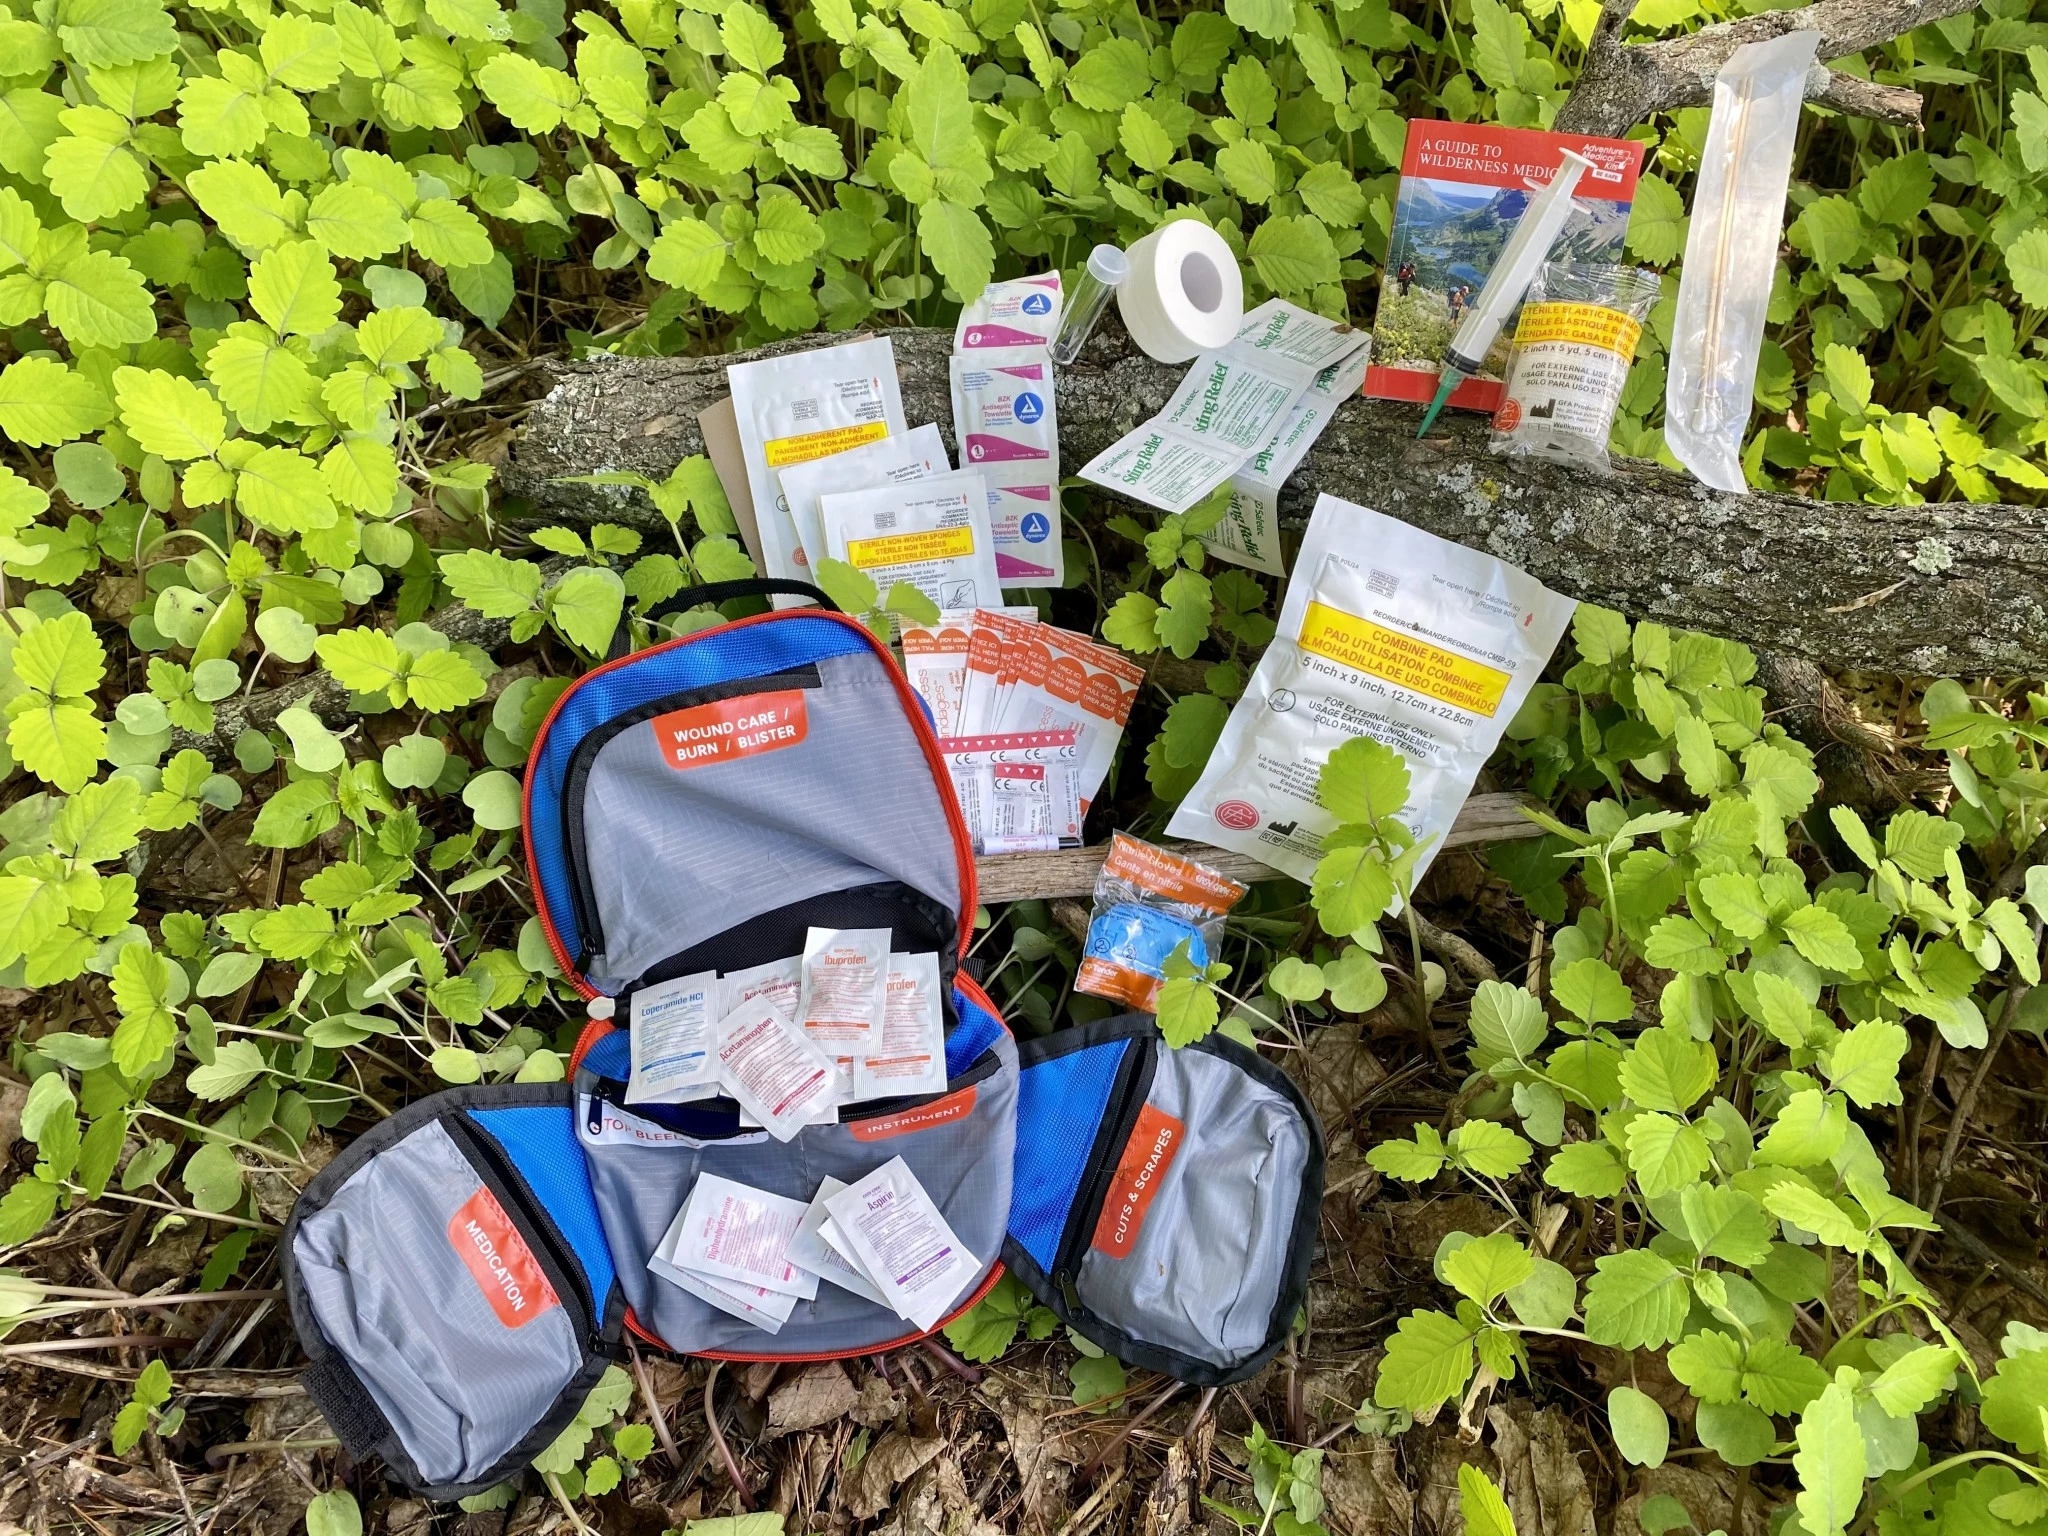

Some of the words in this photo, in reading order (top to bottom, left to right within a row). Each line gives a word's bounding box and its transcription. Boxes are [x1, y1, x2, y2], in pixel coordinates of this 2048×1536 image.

[1422, 139, 1431, 150] A
[1435, 140, 1479, 155] GUIDE
[1484, 145, 1502, 157] TO
[1582, 143, 1624, 155] Adventure
[1582, 151, 1616, 161] Medical
[1420, 153, 1508, 174] WILDERNESS
[1521, 305, 1561, 314] STERILE
[1562, 305, 1604, 318] ELASTIC
[1268, 310, 1291, 334] Relief
[1554, 316, 1609, 331] ÉLASTIQUE
[1255, 331, 1282, 350] Sting
[1517, 329, 1553, 338] VENDAS
[1555, 328, 1568, 336] DE
[1571, 330, 1600, 341] GASA
[1531, 343, 1548, 352] inch
[1593, 350, 1607, 359] cm
[1547, 371, 1585, 382] EXTERNE
[1548, 362, 1590, 375] EXTERNAL
[1592, 370, 1608, 378] USE
[1204, 361, 1229, 401] Relief
[1548, 380, 1570, 388] PARA
[1573, 383, 1590, 392] USO
[982, 403, 1012, 411] Antiseptic
[1176, 389, 1199, 420] Safetec
[1193, 403, 1219, 433] Sting
[788, 428, 846, 445] NON-ADHERENT
[848, 427, 863, 435] PAD
[1284, 417, 1313, 447] Safetec
[775, 443, 819, 456] PANSEMENT
[820, 432, 879, 447] NON-ADHÉRENT
[974, 446, 980, 454] 1
[1136, 433, 1164, 462] Relief
[772, 448, 830, 464] ALMOHADILLAS
[1106, 448, 1133, 467] Safetec
[1122, 461, 1152, 485] Sting
[1255, 510, 1264, 536] Safetec
[859, 539, 885, 549] STERILE
[888, 535, 928, 545] NON-WOVEN
[929, 530, 960, 540] SPONGES
[875, 546, 903, 555] STÉRILE
[920, 540, 947, 550] TISSÉES
[1239, 521, 1266, 562] Relief
[856, 556, 892, 567] ESPONJAS
[892, 551, 929, 564] ESTERILES
[940, 546, 968, 556] TEJIDAS
[1431, 574, 1446, 585] Tear
[1447, 582, 1464, 592] open
[1465, 586, 1480, 597] here
[1485, 593, 1512, 607] Déchirez
[1513, 604, 1521, 612] ici
[1502, 608, 1517, 619] aquí
[1373, 610, 1488, 658] REORDER/COMMANDE/REORDENAR
[1048, 629, 1069, 644] Nudillos
[1074, 643, 1096, 656] Jointure
[1100, 654, 1122, 668] Nudillos
[1372, 630, 1432, 659] COMBINE
[1430, 652, 1454, 668] PAD
[1323, 627, 1350, 644] PAD
[1352, 636, 1428, 672] UTILISATION
[1426, 667, 1485, 695] COMBINEE
[1050, 670, 1065, 681] PULL
[1066, 678, 1082, 688] HERE
[1385, 664, 1401, 678] DE
[1404, 671, 1430, 689] USO
[1431, 683, 1497, 712] COMBINADO
[1086, 686, 1099, 696] PULL
[1101, 694, 1117, 704] HERE
[1303, 656, 1311, 667] 5
[1312, 659, 1338, 678] inch
[1339, 672, 1347, 681] x
[1349, 673, 1358, 685] 9
[1359, 678, 1387, 697] inch,
[1391, 690, 1428, 711] 12.7cm
[1430, 705, 1437, 714] x
[1438, 707, 1474, 727] 22.8cm
[673, 722, 734, 743] WOUND
[737, 711, 777, 731] CARE
[1308, 700, 1343, 717] USAGE
[1341, 713, 1382, 732] EXTERNE
[1383, 726, 1440, 753] UNIQUEMENT
[1325, 696, 1345, 709] FOR
[1345, 704, 1390, 723] EXTERNAL
[1392, 719, 1410, 730] USE
[1410, 726, 1436, 740] ONLY
[676, 742, 718, 761] BURN
[737, 724, 796, 748] BLISTER
[1314, 714, 1339, 728] SOLO
[1339, 723, 1365, 737] PARA
[1384, 736, 1426, 759] EXTERNO
[1268, 758, 1293, 772] stérilité
[1268, 765, 1290, 780] sachet
[1291, 761, 1319, 775] package
[1280, 779, 1316, 796] Esterilidad
[1119, 841, 1145, 860] Nitrile
[1149, 855, 1182, 875] Gloves
[1114, 856, 1140, 874] Gants
[1143, 870, 1155, 881] en
[1157, 876, 1184, 892] nitrile
[1099, 940, 1105, 949] 2
[1126, 948, 1133, 959] 2
[824, 955, 867, 966] Ibuprofen
[1093, 964, 1118, 977] Tender
[744, 981, 802, 1001] Acetaminophe
[886, 979, 916, 993] profen
[642, 997, 687, 1016] Loperamide
[719, 1017, 774, 1062] Acetaminophen
[603, 1118, 631, 1131] TOP
[866, 1105, 963, 1134] INSTRUMENT
[1115, 1204, 1133, 1244] CUTS
[1128, 1192, 1139, 1203] &
[1135, 1128, 1172, 1190] SCRAPES
[867, 1191, 895, 1211] Aspirin
[707, 1196, 733, 1260] Diphenhydramine
[465, 1219, 527, 1311] MEDICATION
